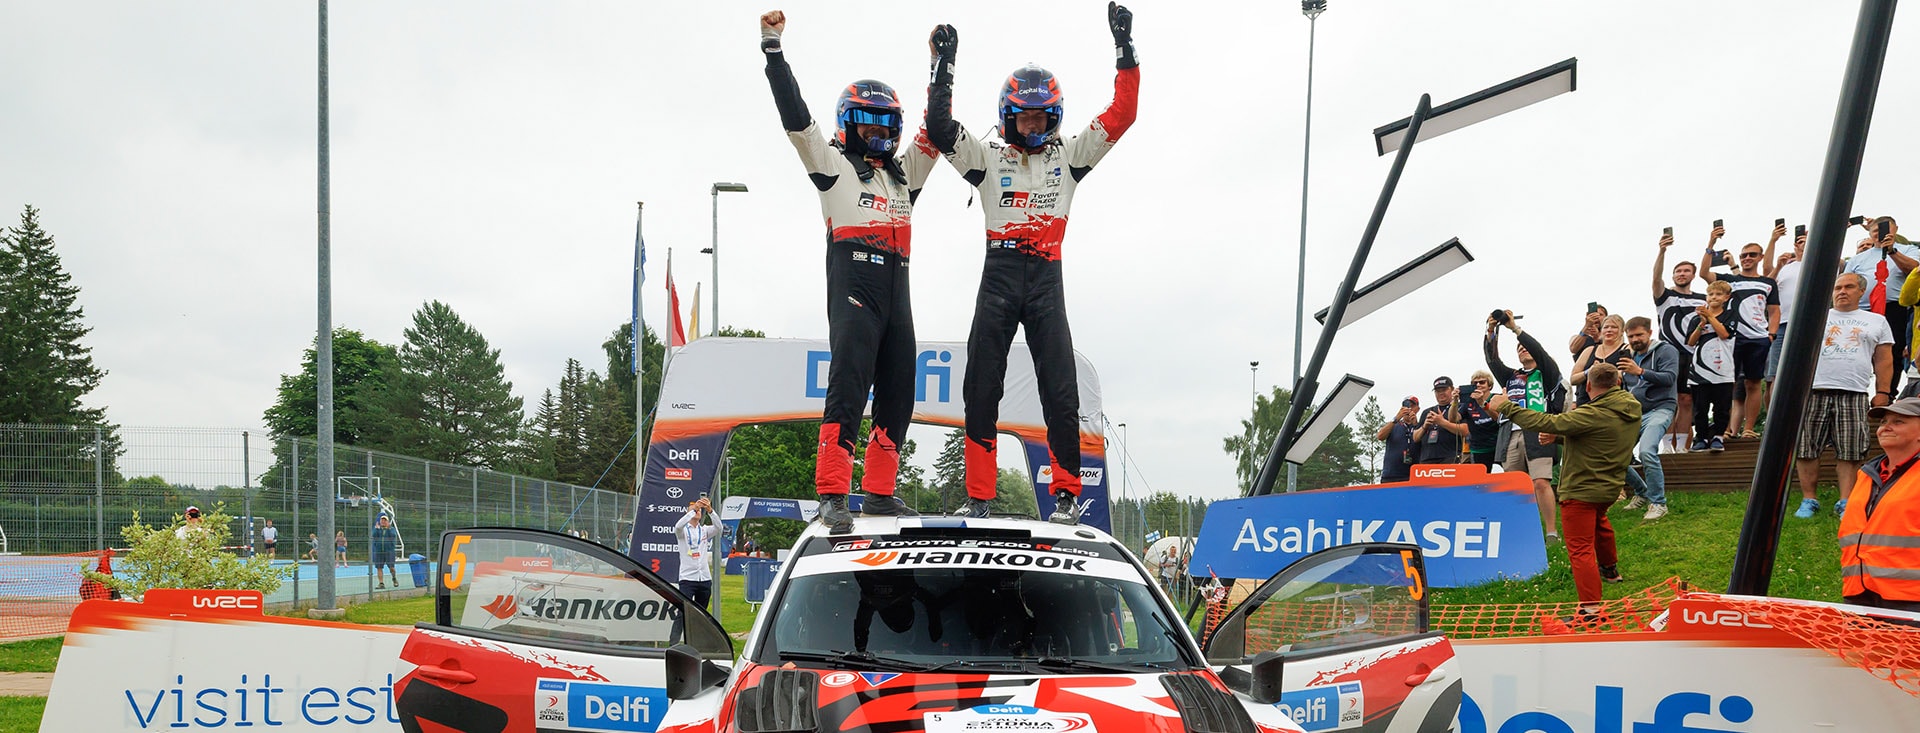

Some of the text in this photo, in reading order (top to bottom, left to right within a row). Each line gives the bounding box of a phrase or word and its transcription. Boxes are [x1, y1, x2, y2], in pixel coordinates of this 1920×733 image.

[860, 197, 887, 212] GR
[1000, 197, 1027, 208] GR
[805, 350, 952, 403] Dfi
[1528, 380, 1544, 406] 243
[668, 449, 700, 461] Delfi
[1415, 468, 1457, 478] WRC
[876, 540, 956, 548] TOYOTA
[957, 539, 1032, 549] GAZOO
[1035, 544, 1100, 557] Racing
[443, 535, 472, 590] 5
[521, 560, 549, 568] WRC
[1399, 550, 1423, 600] 5
[193, 595, 258, 609] WRC
[1683, 608, 1774, 629] WRC
[125, 673, 401, 729] visit est
[585, 695, 650, 723] Delfi
[988, 706, 1023, 714] Delfi
[539, 713, 565, 722] 2026
[934, 714, 942, 722] 5
[1341, 714, 1361, 722] 2026
